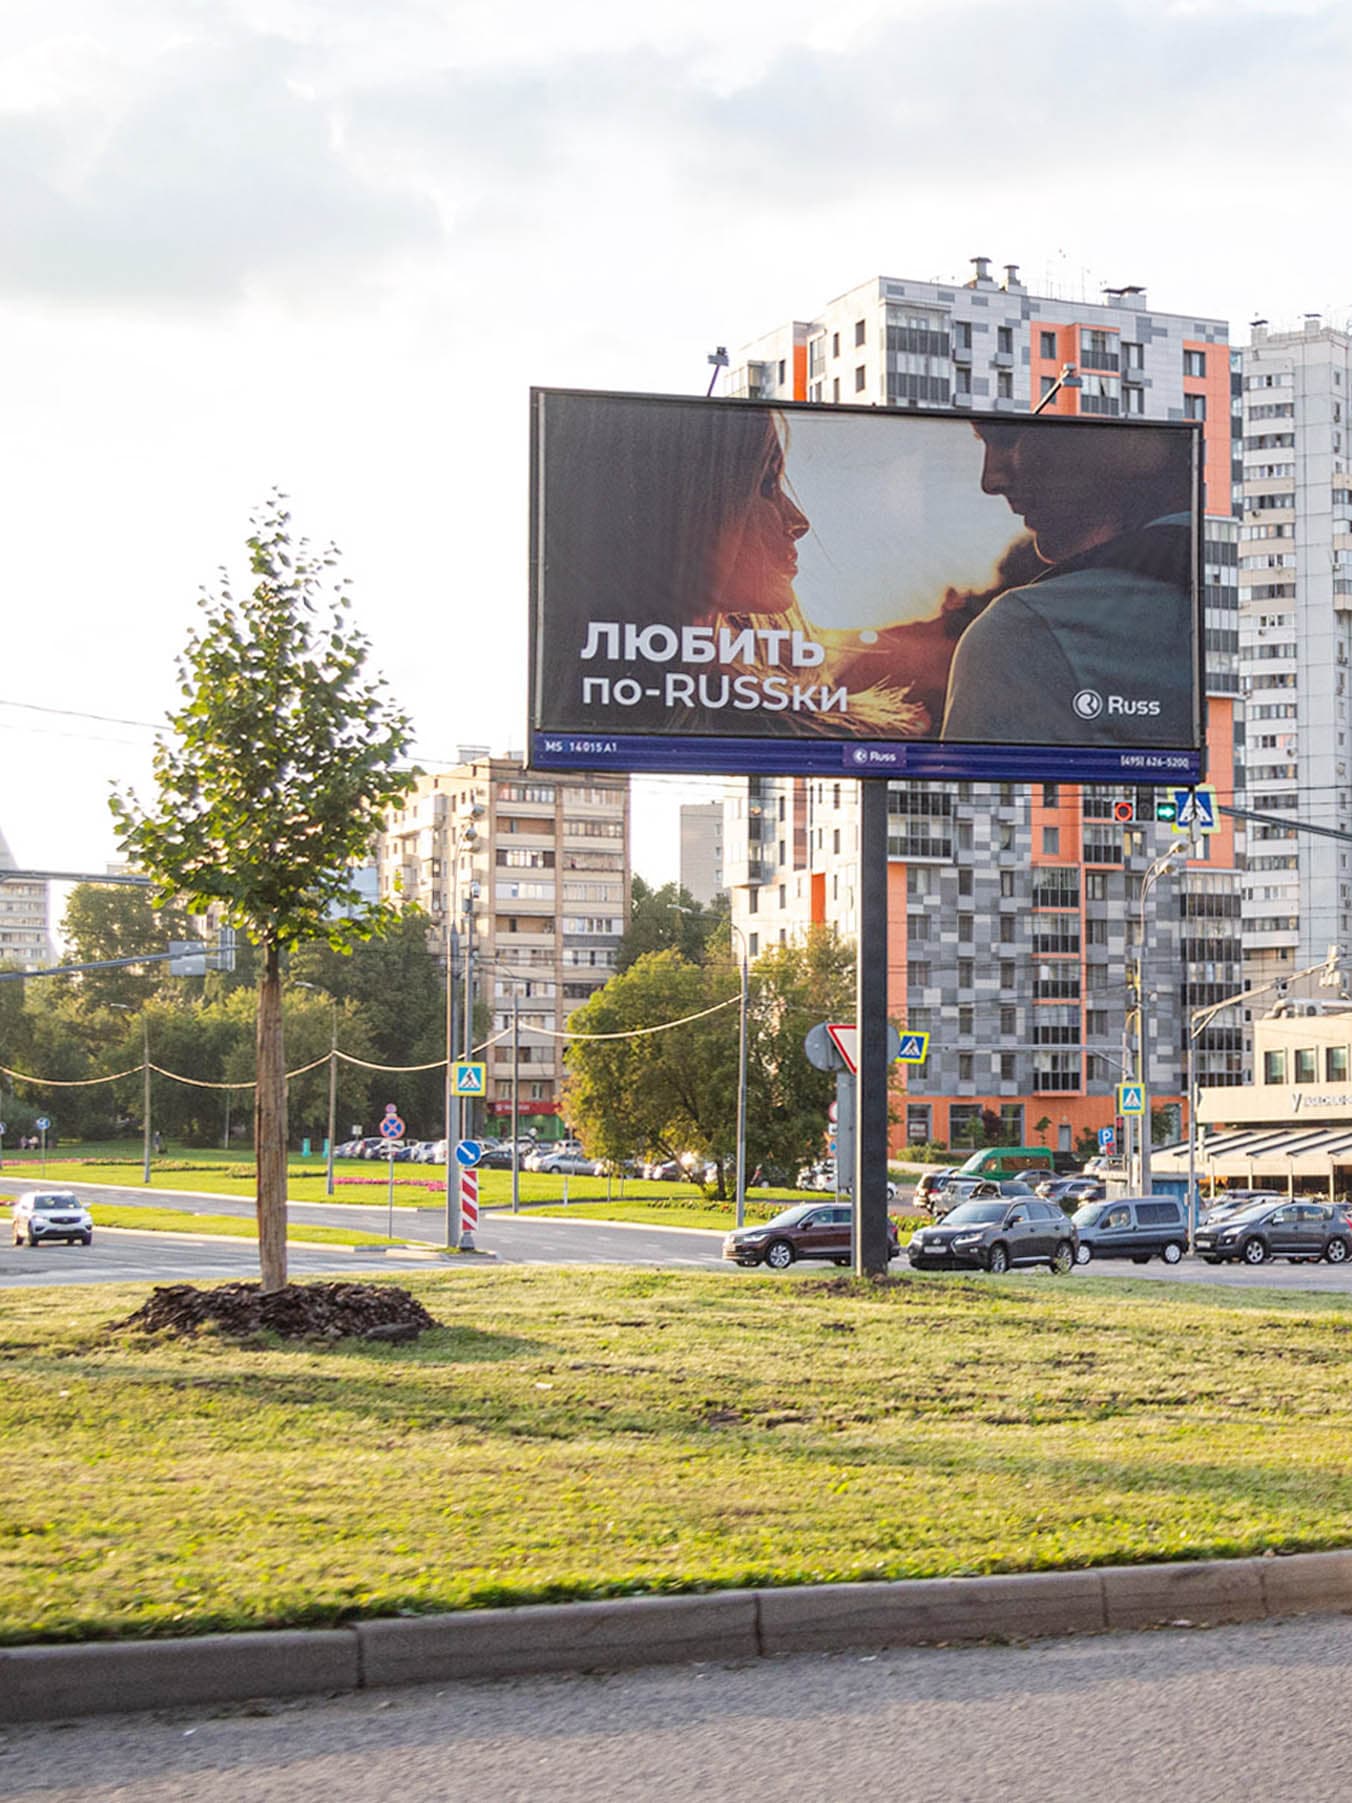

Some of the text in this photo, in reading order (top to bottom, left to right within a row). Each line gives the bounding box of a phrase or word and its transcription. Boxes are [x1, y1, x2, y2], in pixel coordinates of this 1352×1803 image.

[580, 621, 825, 667] ЛЮБИТЬ
[582, 673, 848, 713] по-RUSSки
[1108, 695, 1161, 716] Russ
[869, 750, 897, 762] Russ
